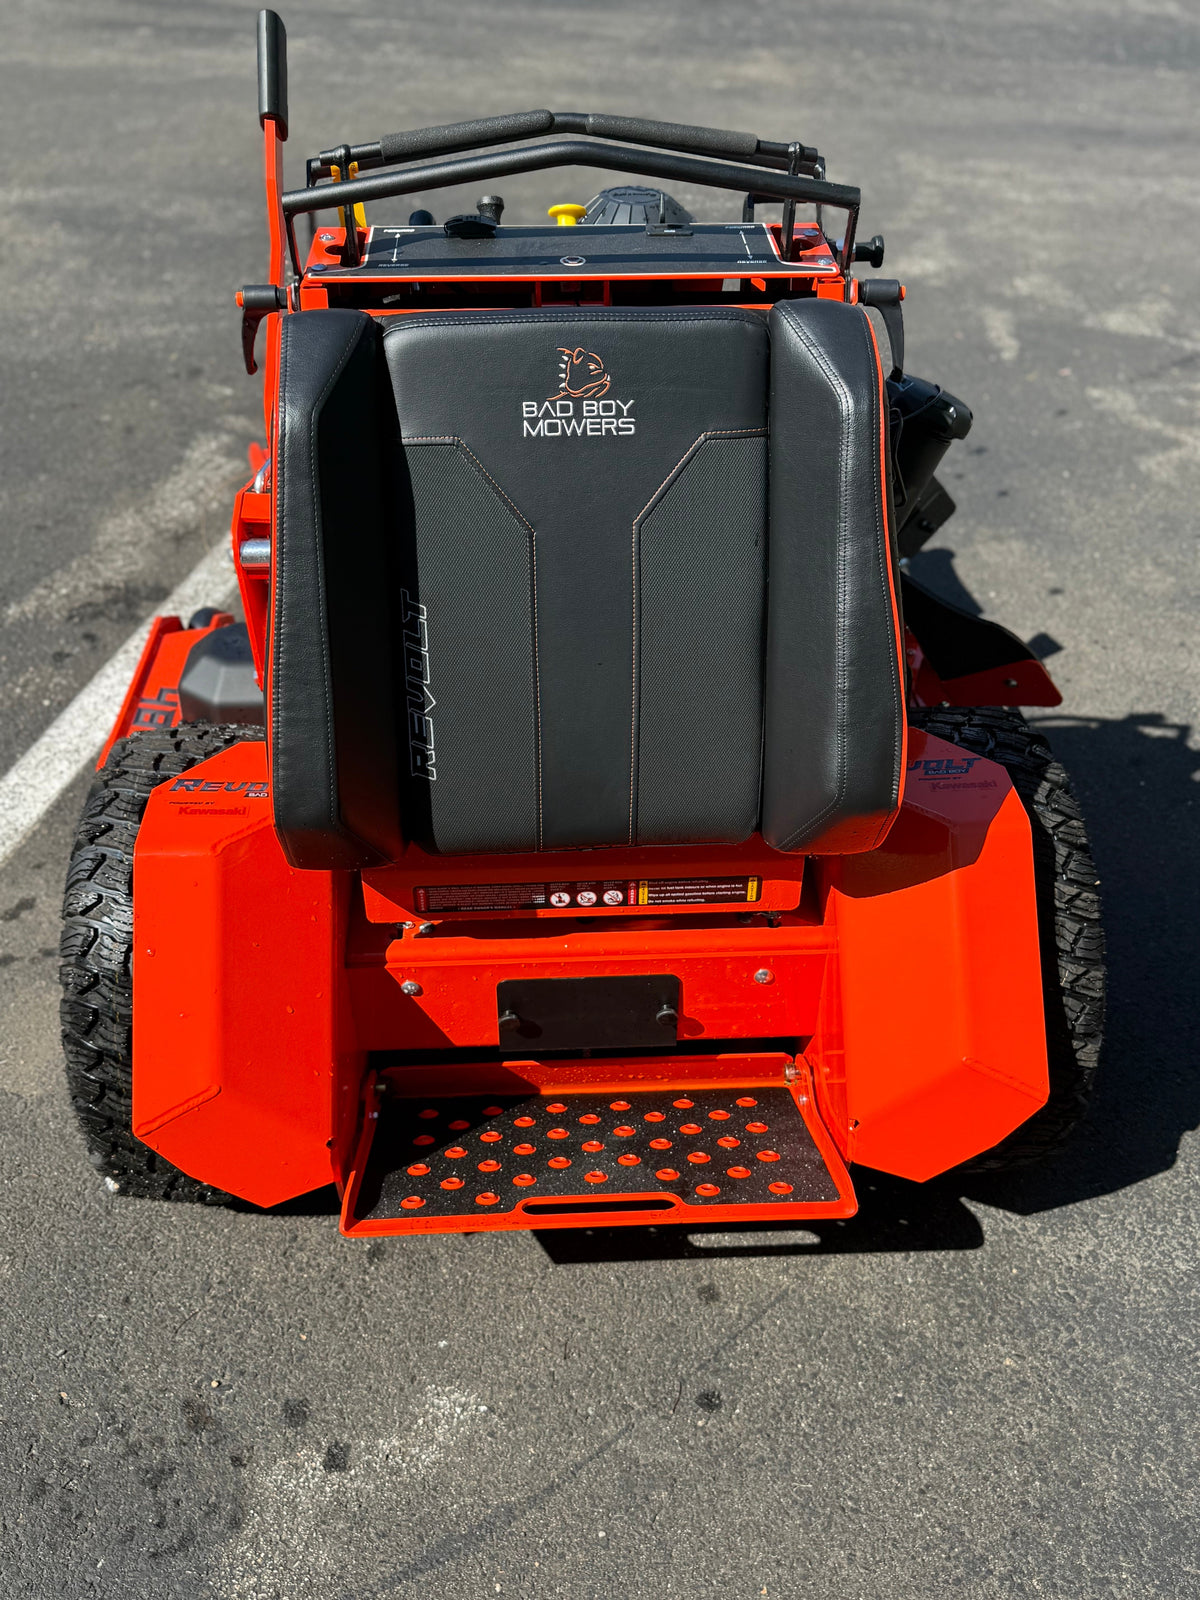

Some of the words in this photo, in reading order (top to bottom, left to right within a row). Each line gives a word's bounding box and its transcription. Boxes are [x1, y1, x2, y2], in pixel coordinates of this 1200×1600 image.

[522, 401, 573, 417] BAD
[583, 400, 635, 417] BOY
[523, 418, 636, 437] MOWERS
[400, 588, 437, 781] REVOLT
[907, 757, 982, 770] VOLT
[169, 778, 269, 792] REVO
[931, 780, 998, 791] Kawasaki
[178, 806, 247, 816] Kawasaki
